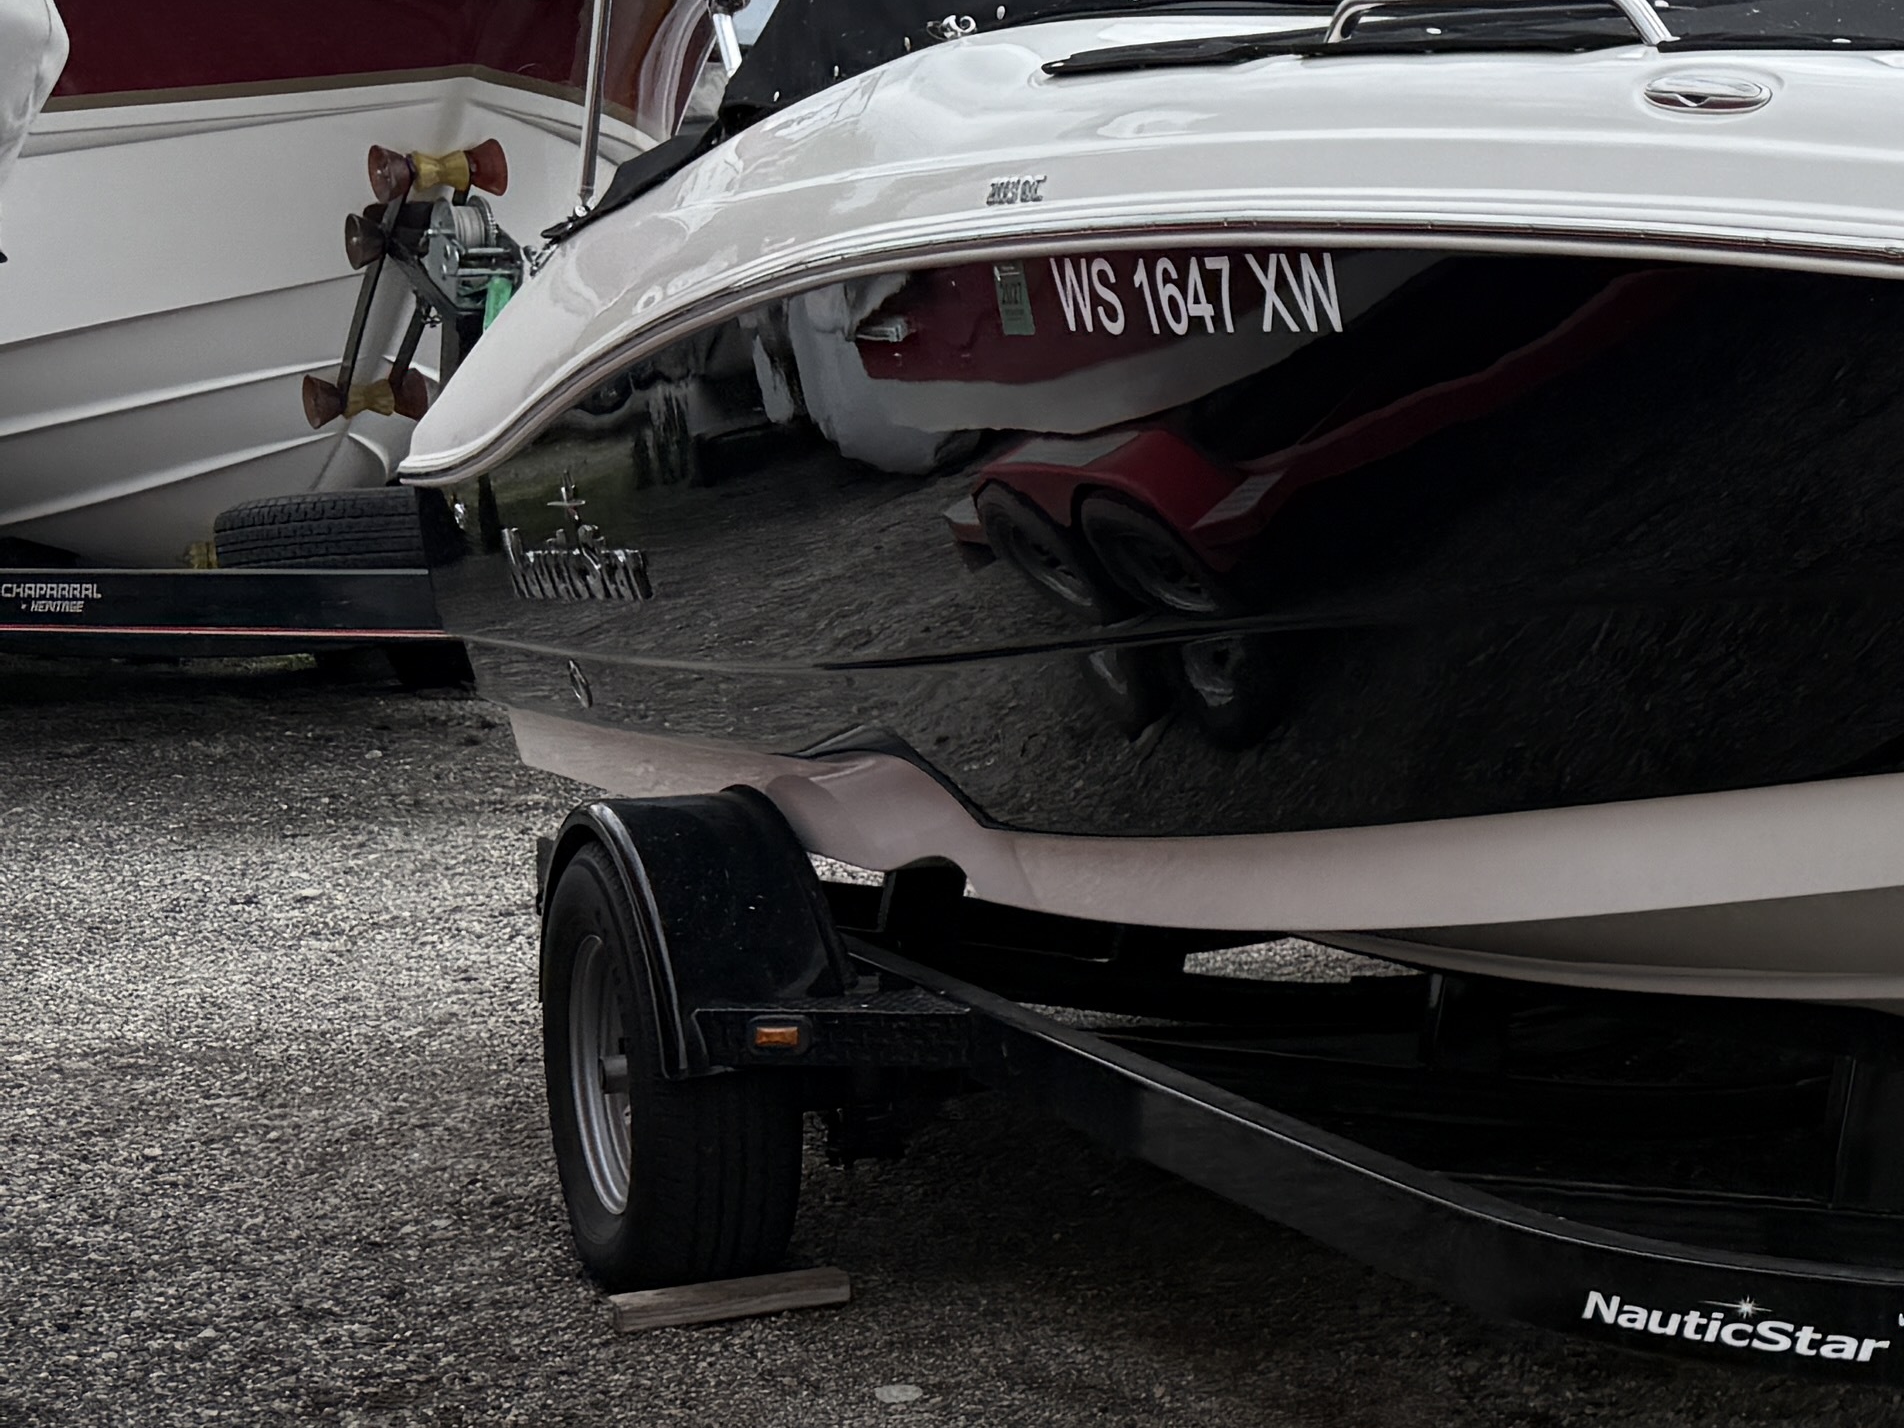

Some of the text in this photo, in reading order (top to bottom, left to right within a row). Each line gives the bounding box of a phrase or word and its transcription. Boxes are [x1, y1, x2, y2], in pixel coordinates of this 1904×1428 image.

[1050, 252, 1344, 336] WS 1647 XW
[1, 583, 102, 599] CHAPARRAL
[1582, 1290, 1891, 1362] NauticStar
